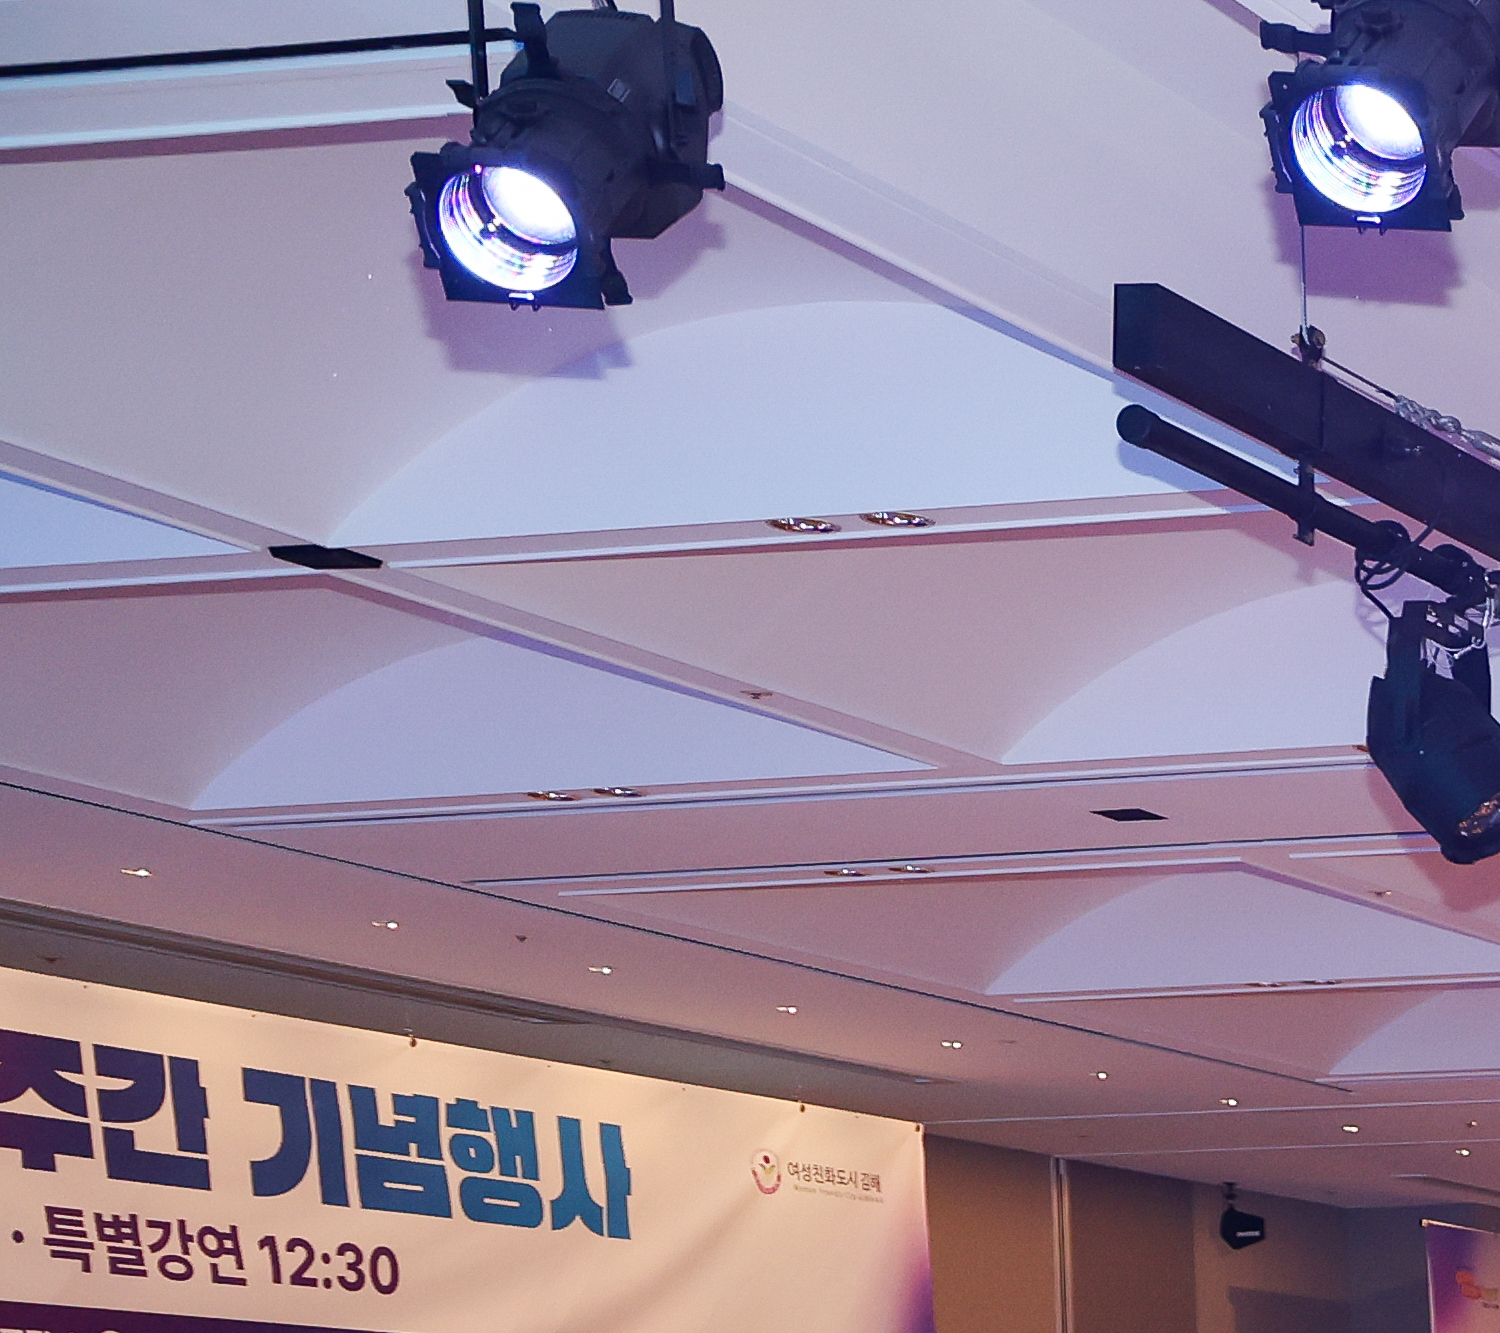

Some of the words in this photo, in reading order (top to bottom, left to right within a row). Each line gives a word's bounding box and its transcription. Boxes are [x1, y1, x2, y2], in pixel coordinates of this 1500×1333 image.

[241, 1067, 631, 1239] 기념행사
[42, 1206, 248, 1287] 특별강연
[258, 1233, 400, 1295] 12:30
